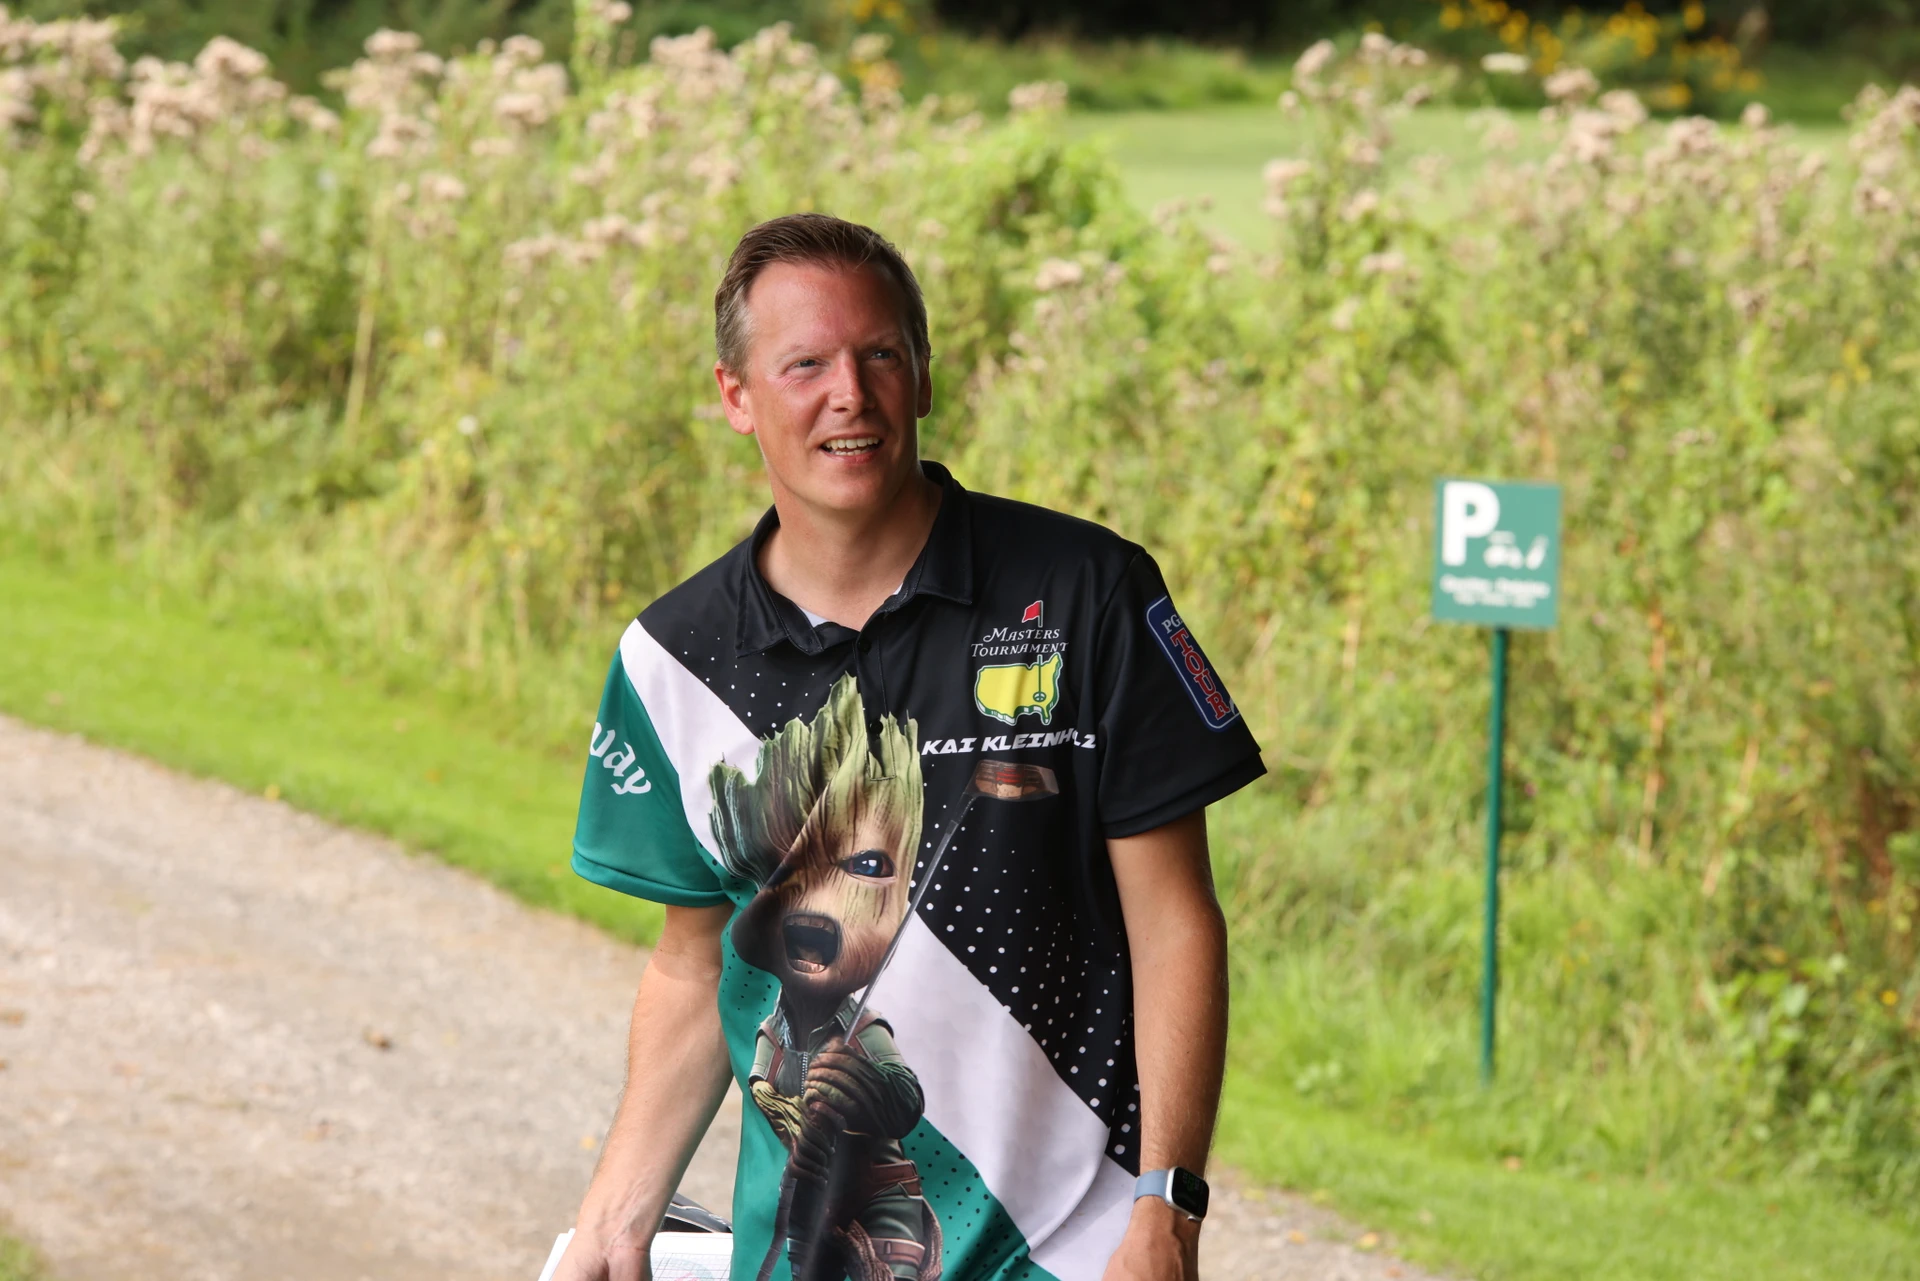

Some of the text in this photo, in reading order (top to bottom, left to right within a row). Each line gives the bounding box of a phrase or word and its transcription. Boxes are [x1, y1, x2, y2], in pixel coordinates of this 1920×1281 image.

[1442, 480, 1500, 566] P
[1161, 614, 1183, 634] PG
[982, 627, 1060, 642] MASTERS
[970, 642, 1069, 657] TOURNAMENT
[1169, 627, 1231, 721] TOUR
[921, 736, 978, 756] KAI
